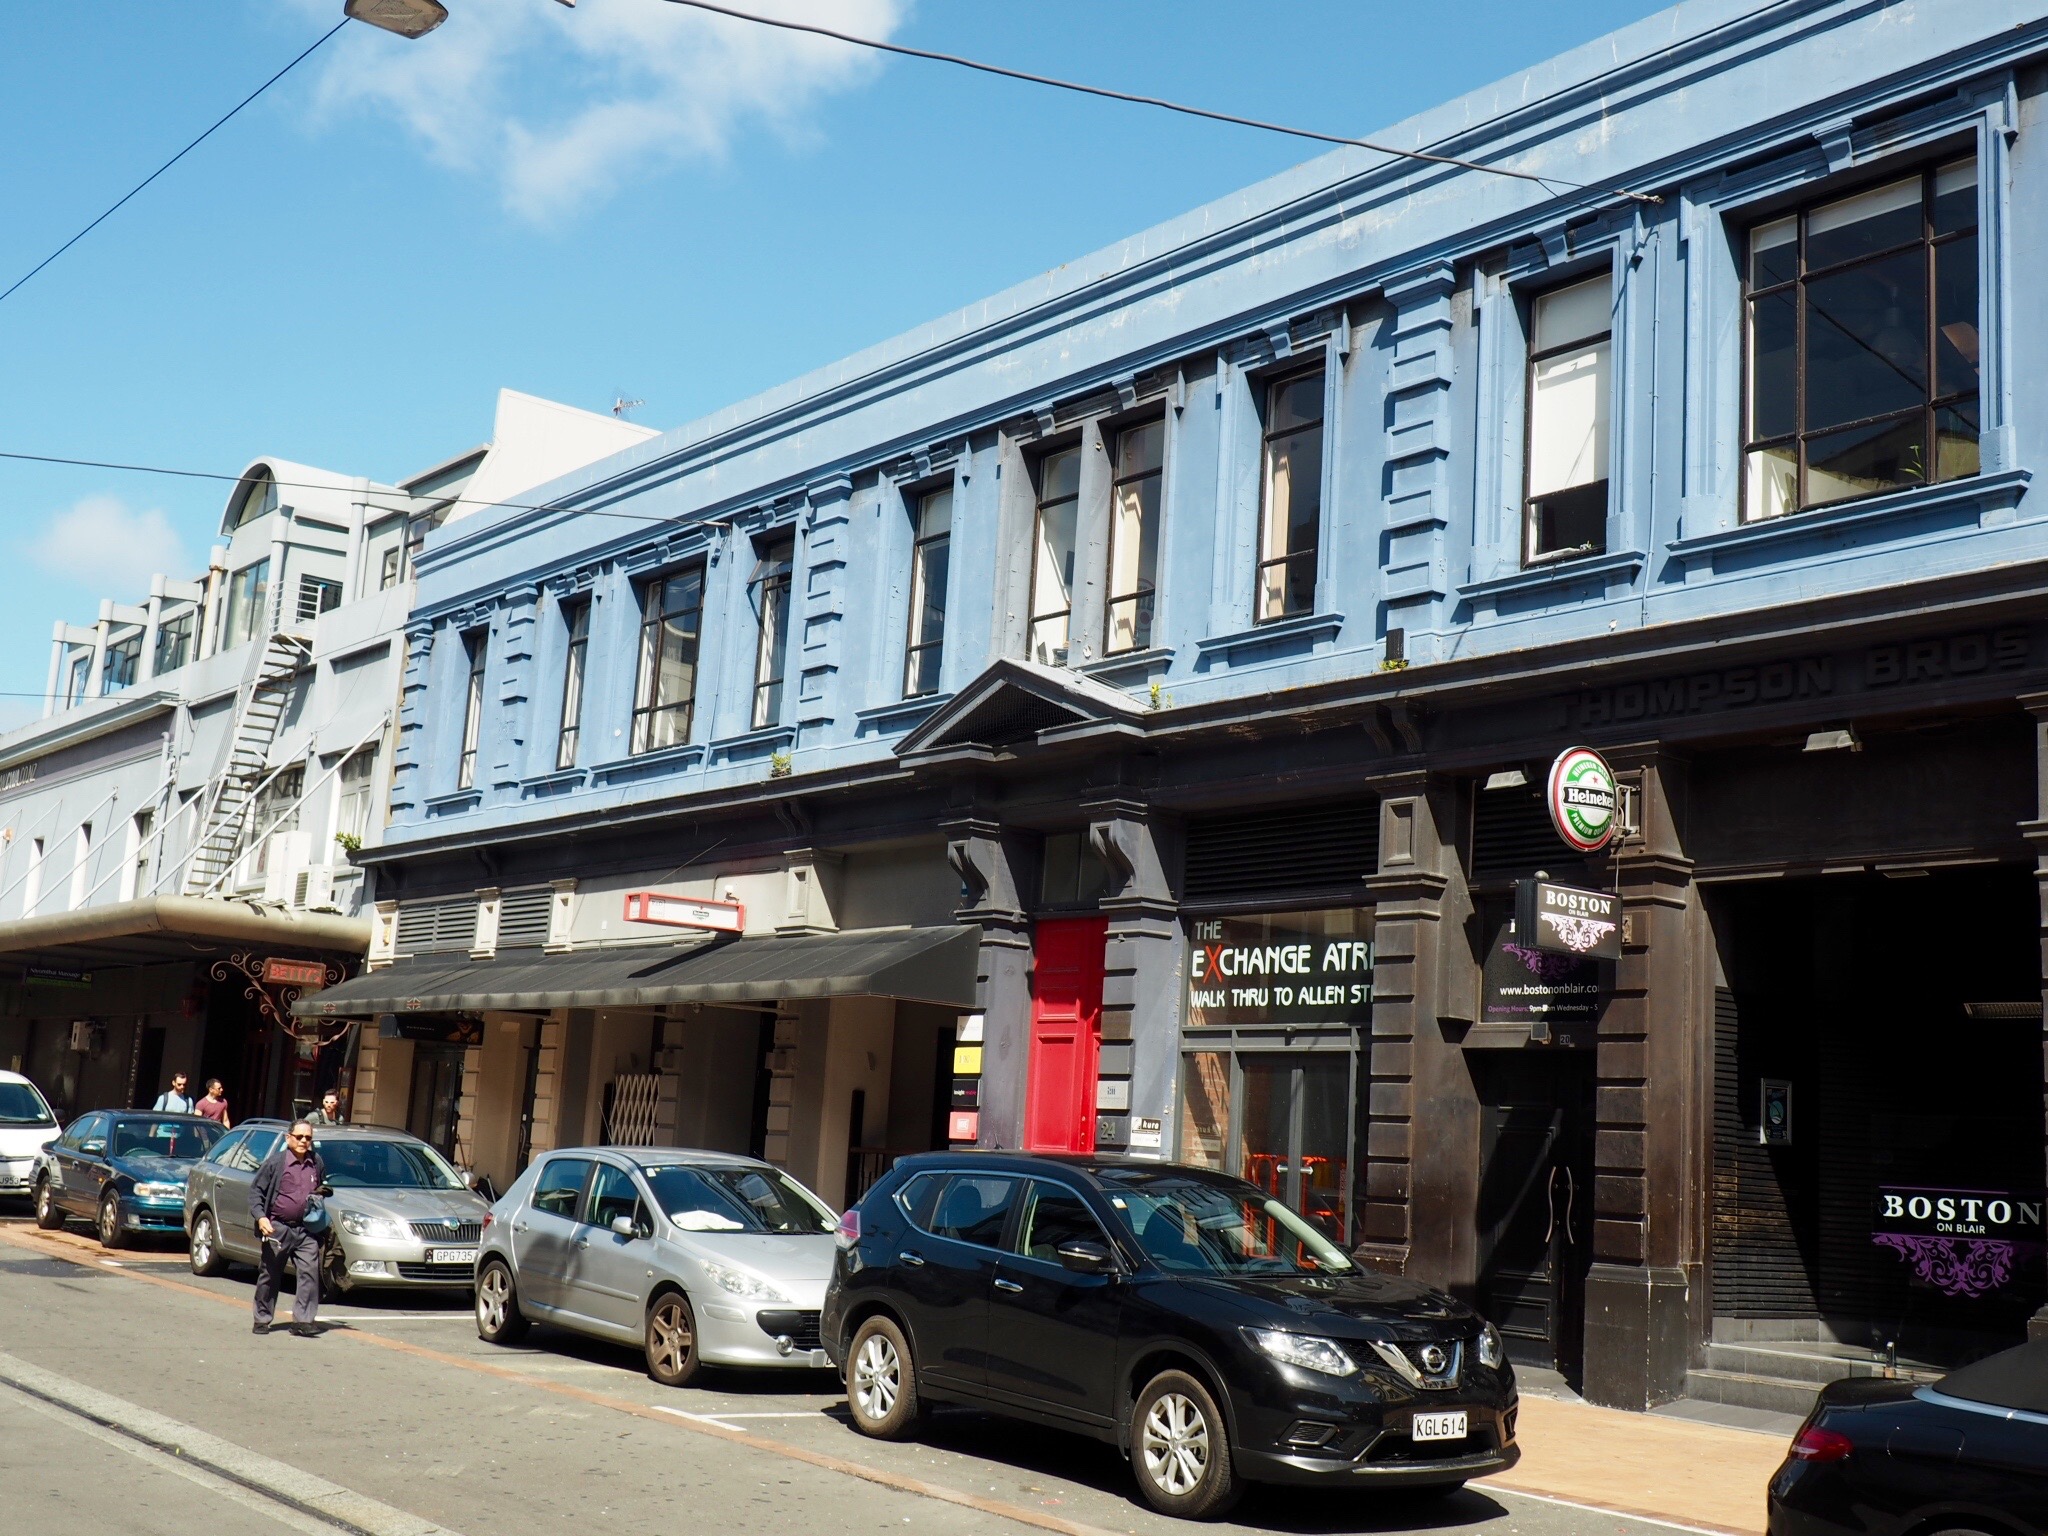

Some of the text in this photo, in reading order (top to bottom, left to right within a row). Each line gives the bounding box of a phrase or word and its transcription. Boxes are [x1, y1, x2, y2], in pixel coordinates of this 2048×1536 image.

[1549, 628, 2029, 730] THOMPSON BROS
[1546, 890, 1611, 914] BOSTON
[1195, 920, 1222, 940] THE
[1192, 944, 1312, 983] EXCHANGE
[1190, 989, 1226, 1008] WALK
[1231, 987, 1269, 1007] THRU
[1273, 986, 1293, 1006] TO
[1297, 984, 1345, 1005] ALLEN
[1499, 983, 1600, 996] www.bostononblair.co
[1487, 1005, 1510, 1014] Opening
[1556, 1003, 1589, 1013] Wednesday
[1560, 1035, 1570, 1044] 20
[1100, 1121, 1116, 1141] 24
[1883, 1194, 2043, 1226] BOSTON
[1936, 1222, 1986, 1235] ON BLAIR
[436, 1251, 474, 1262] GPG735
[1416, 1416, 1466, 1437] KGL614
